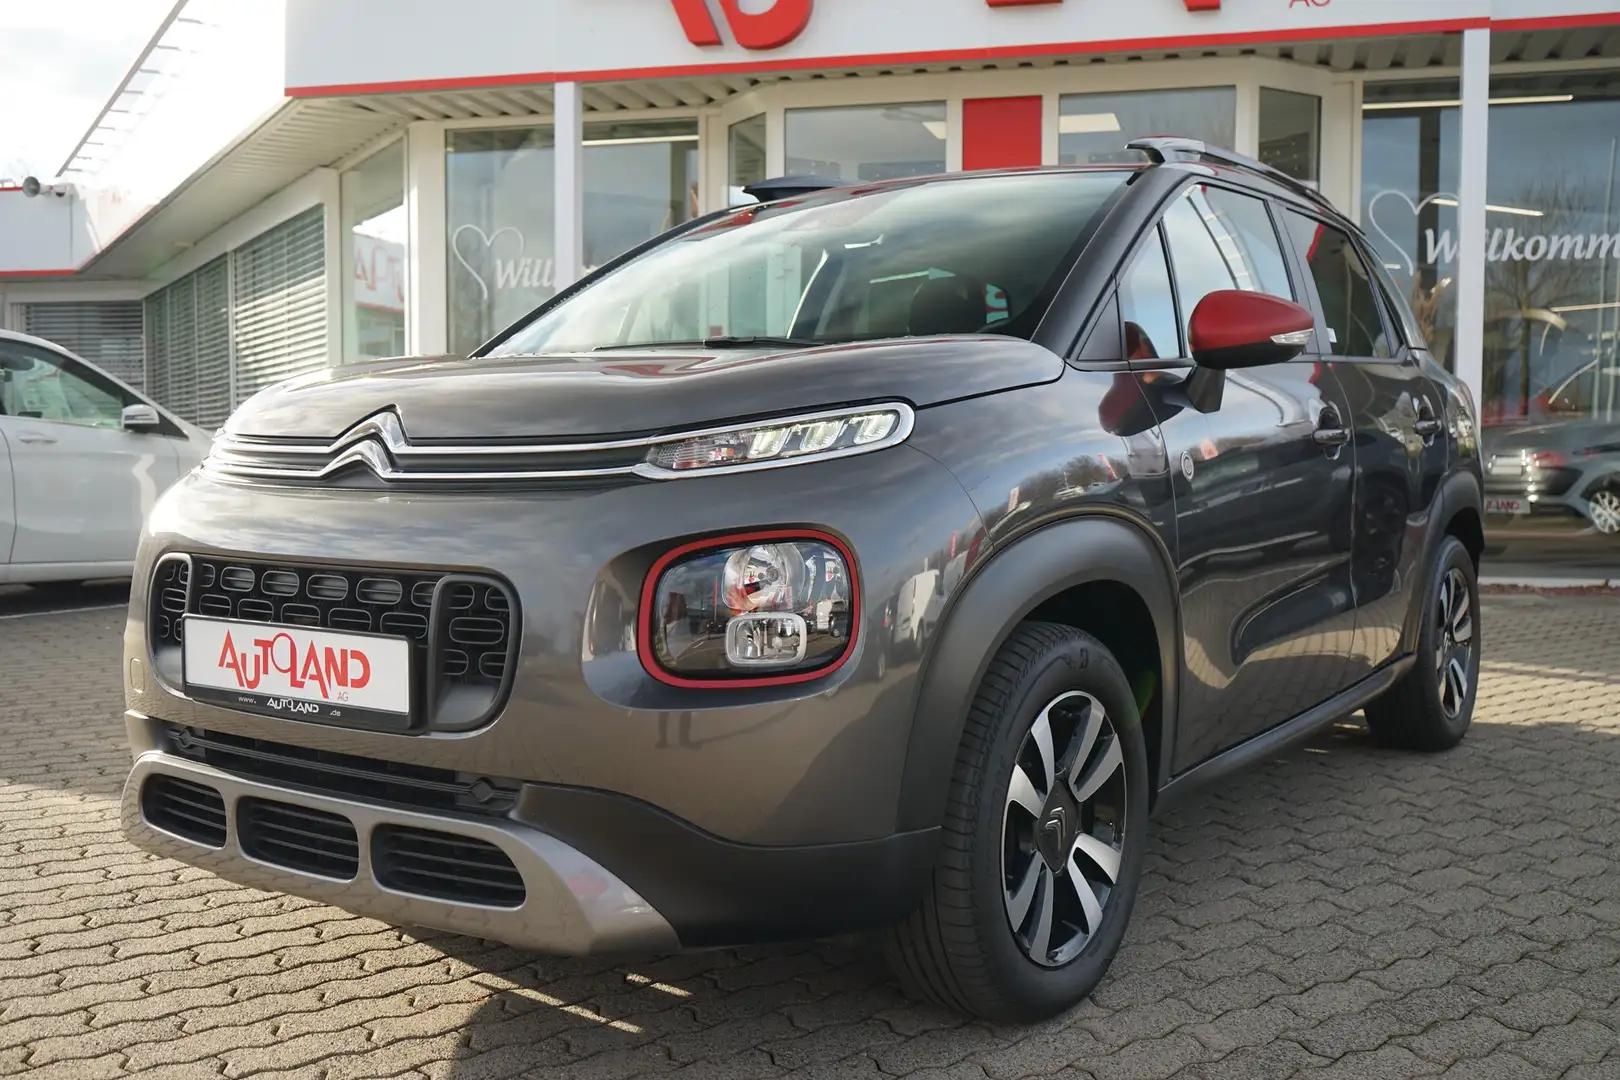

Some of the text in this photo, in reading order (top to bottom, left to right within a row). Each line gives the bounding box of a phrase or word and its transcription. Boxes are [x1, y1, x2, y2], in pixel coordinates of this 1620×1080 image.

[1425, 228, 1620, 265] Wlkomm
[496, 257, 555, 289] Will
[218, 629, 371, 699] AUTOLAND
[267, 697, 319, 714] AUTOLAND
[336, 691, 349, 702] AG
